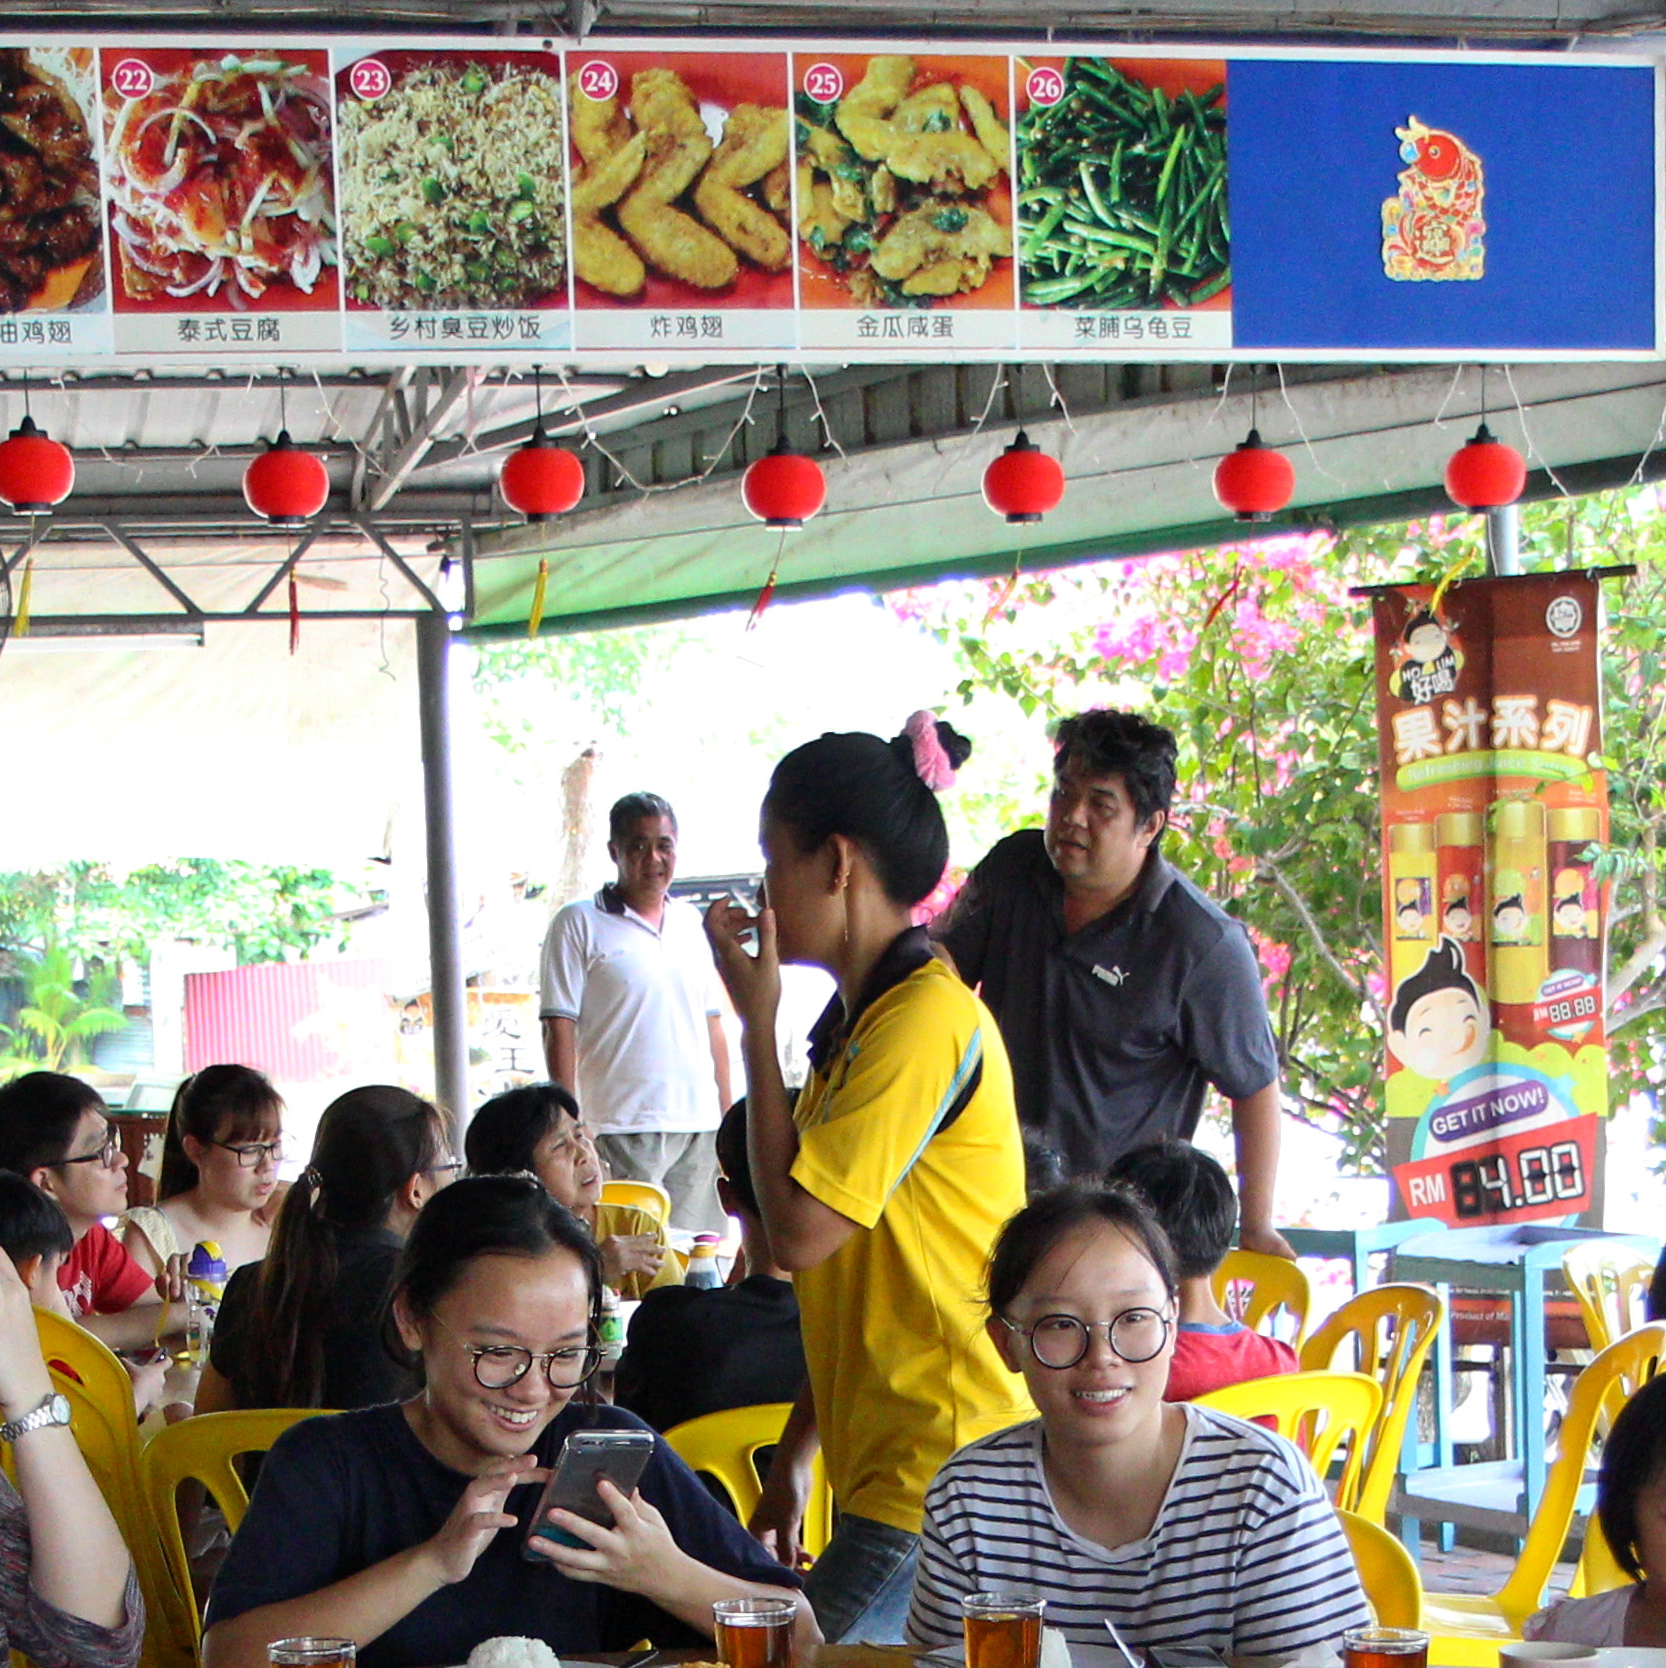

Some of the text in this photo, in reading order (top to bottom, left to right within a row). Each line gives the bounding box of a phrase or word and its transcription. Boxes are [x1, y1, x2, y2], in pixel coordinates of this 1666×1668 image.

[118, 69, 148, 91] 22
[356, 69, 385, 92] 23
[584, 70, 613, 93] 24
[809, 73, 837, 95] 25
[1031, 76, 1060, 98] 26
[176, 317, 281, 343] 泰式豆腐
[388, 315, 542, 340] 乡村臭豆炒饭
[649, 315, 725, 340] 炸鸡翅
[856, 315, 955, 339] 金瓜咸蛋
[1073, 315, 1193, 340] 菜脯乌龟豆
[1402, 655, 1455, 682] HO LIM
[1392, 696, 1592, 764] 果汁系列
[1431, 1086, 1545, 1138] GET IT NOW!
[1408, 1172, 1446, 1208] RM
